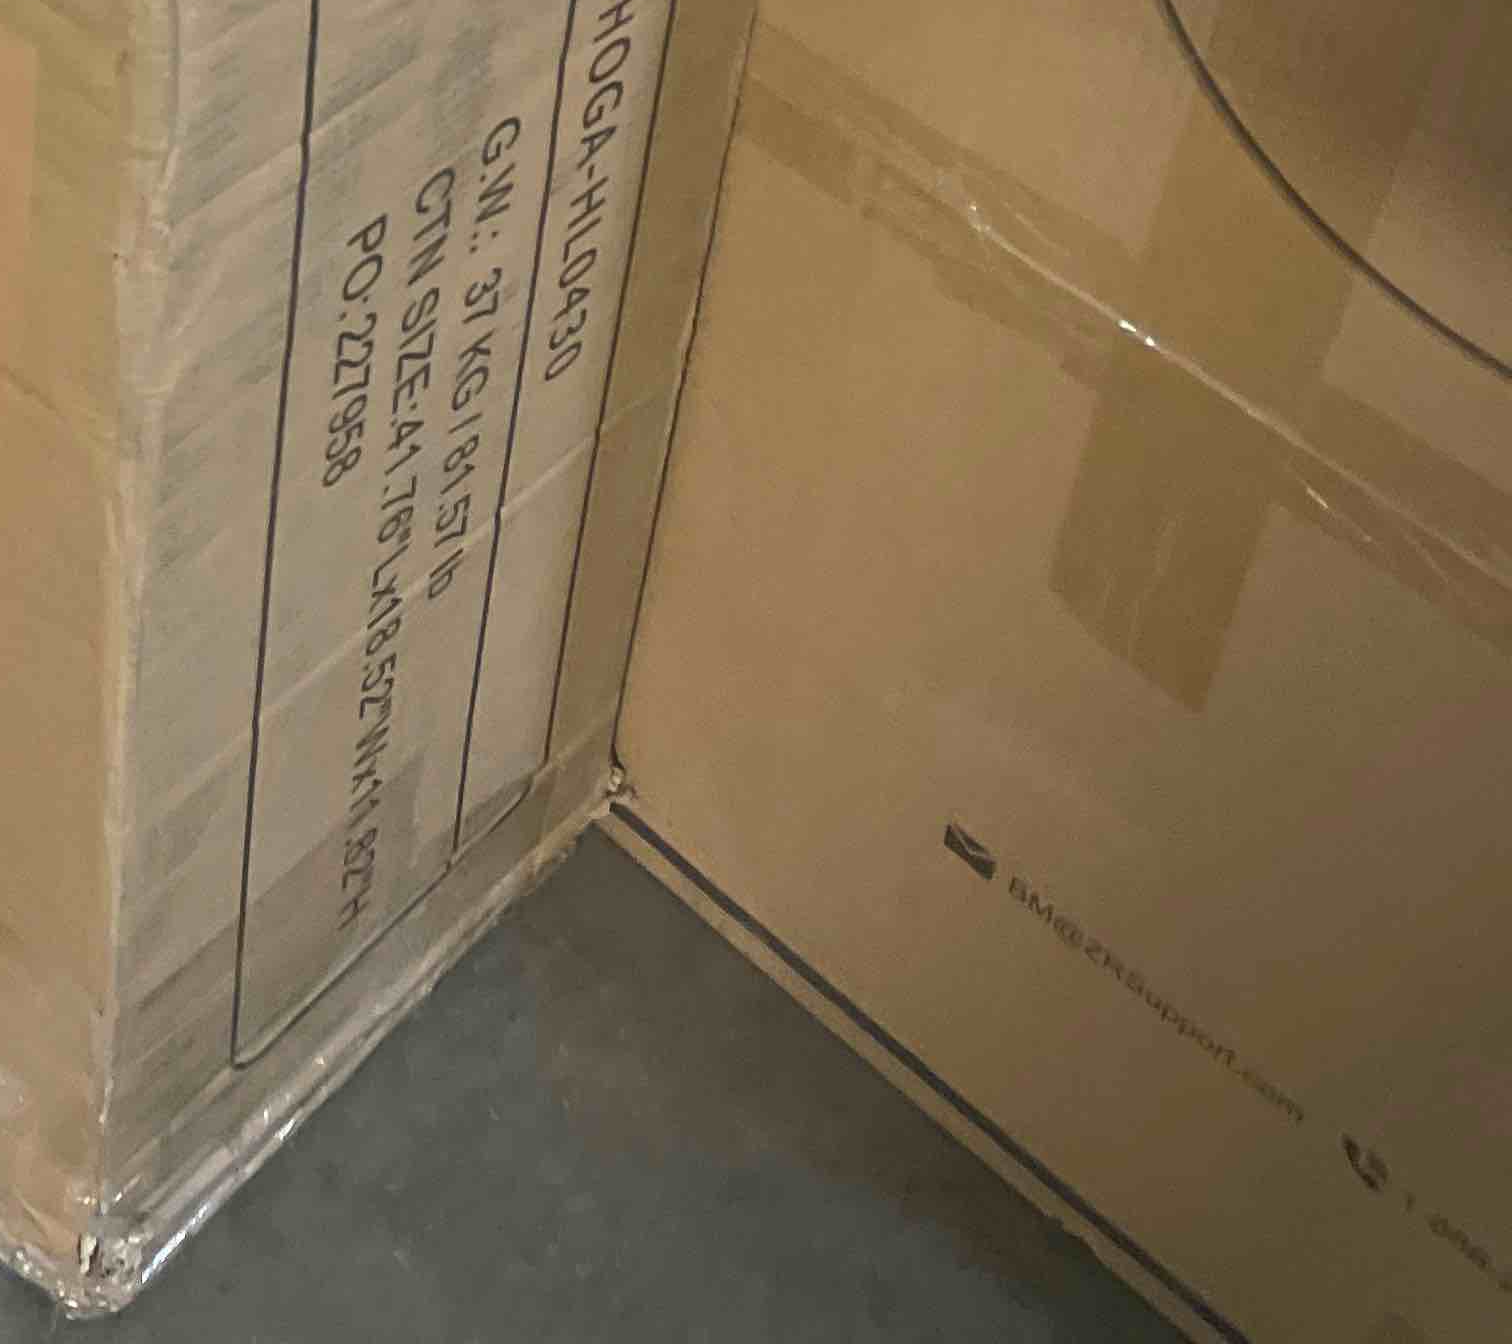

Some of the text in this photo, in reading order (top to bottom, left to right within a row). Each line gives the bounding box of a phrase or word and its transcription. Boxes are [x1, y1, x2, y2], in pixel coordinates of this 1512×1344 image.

[408, 167, 456, 287] CTN
[469, 117, 521, 254] G.W.:
[322, 214, 387, 488] PO:227958
[462, 267, 502, 324] 37
[451, 330, 492, 411] KG
[434, 434, 480, 548] 81.57
[428, 548, 464, 599] lb
